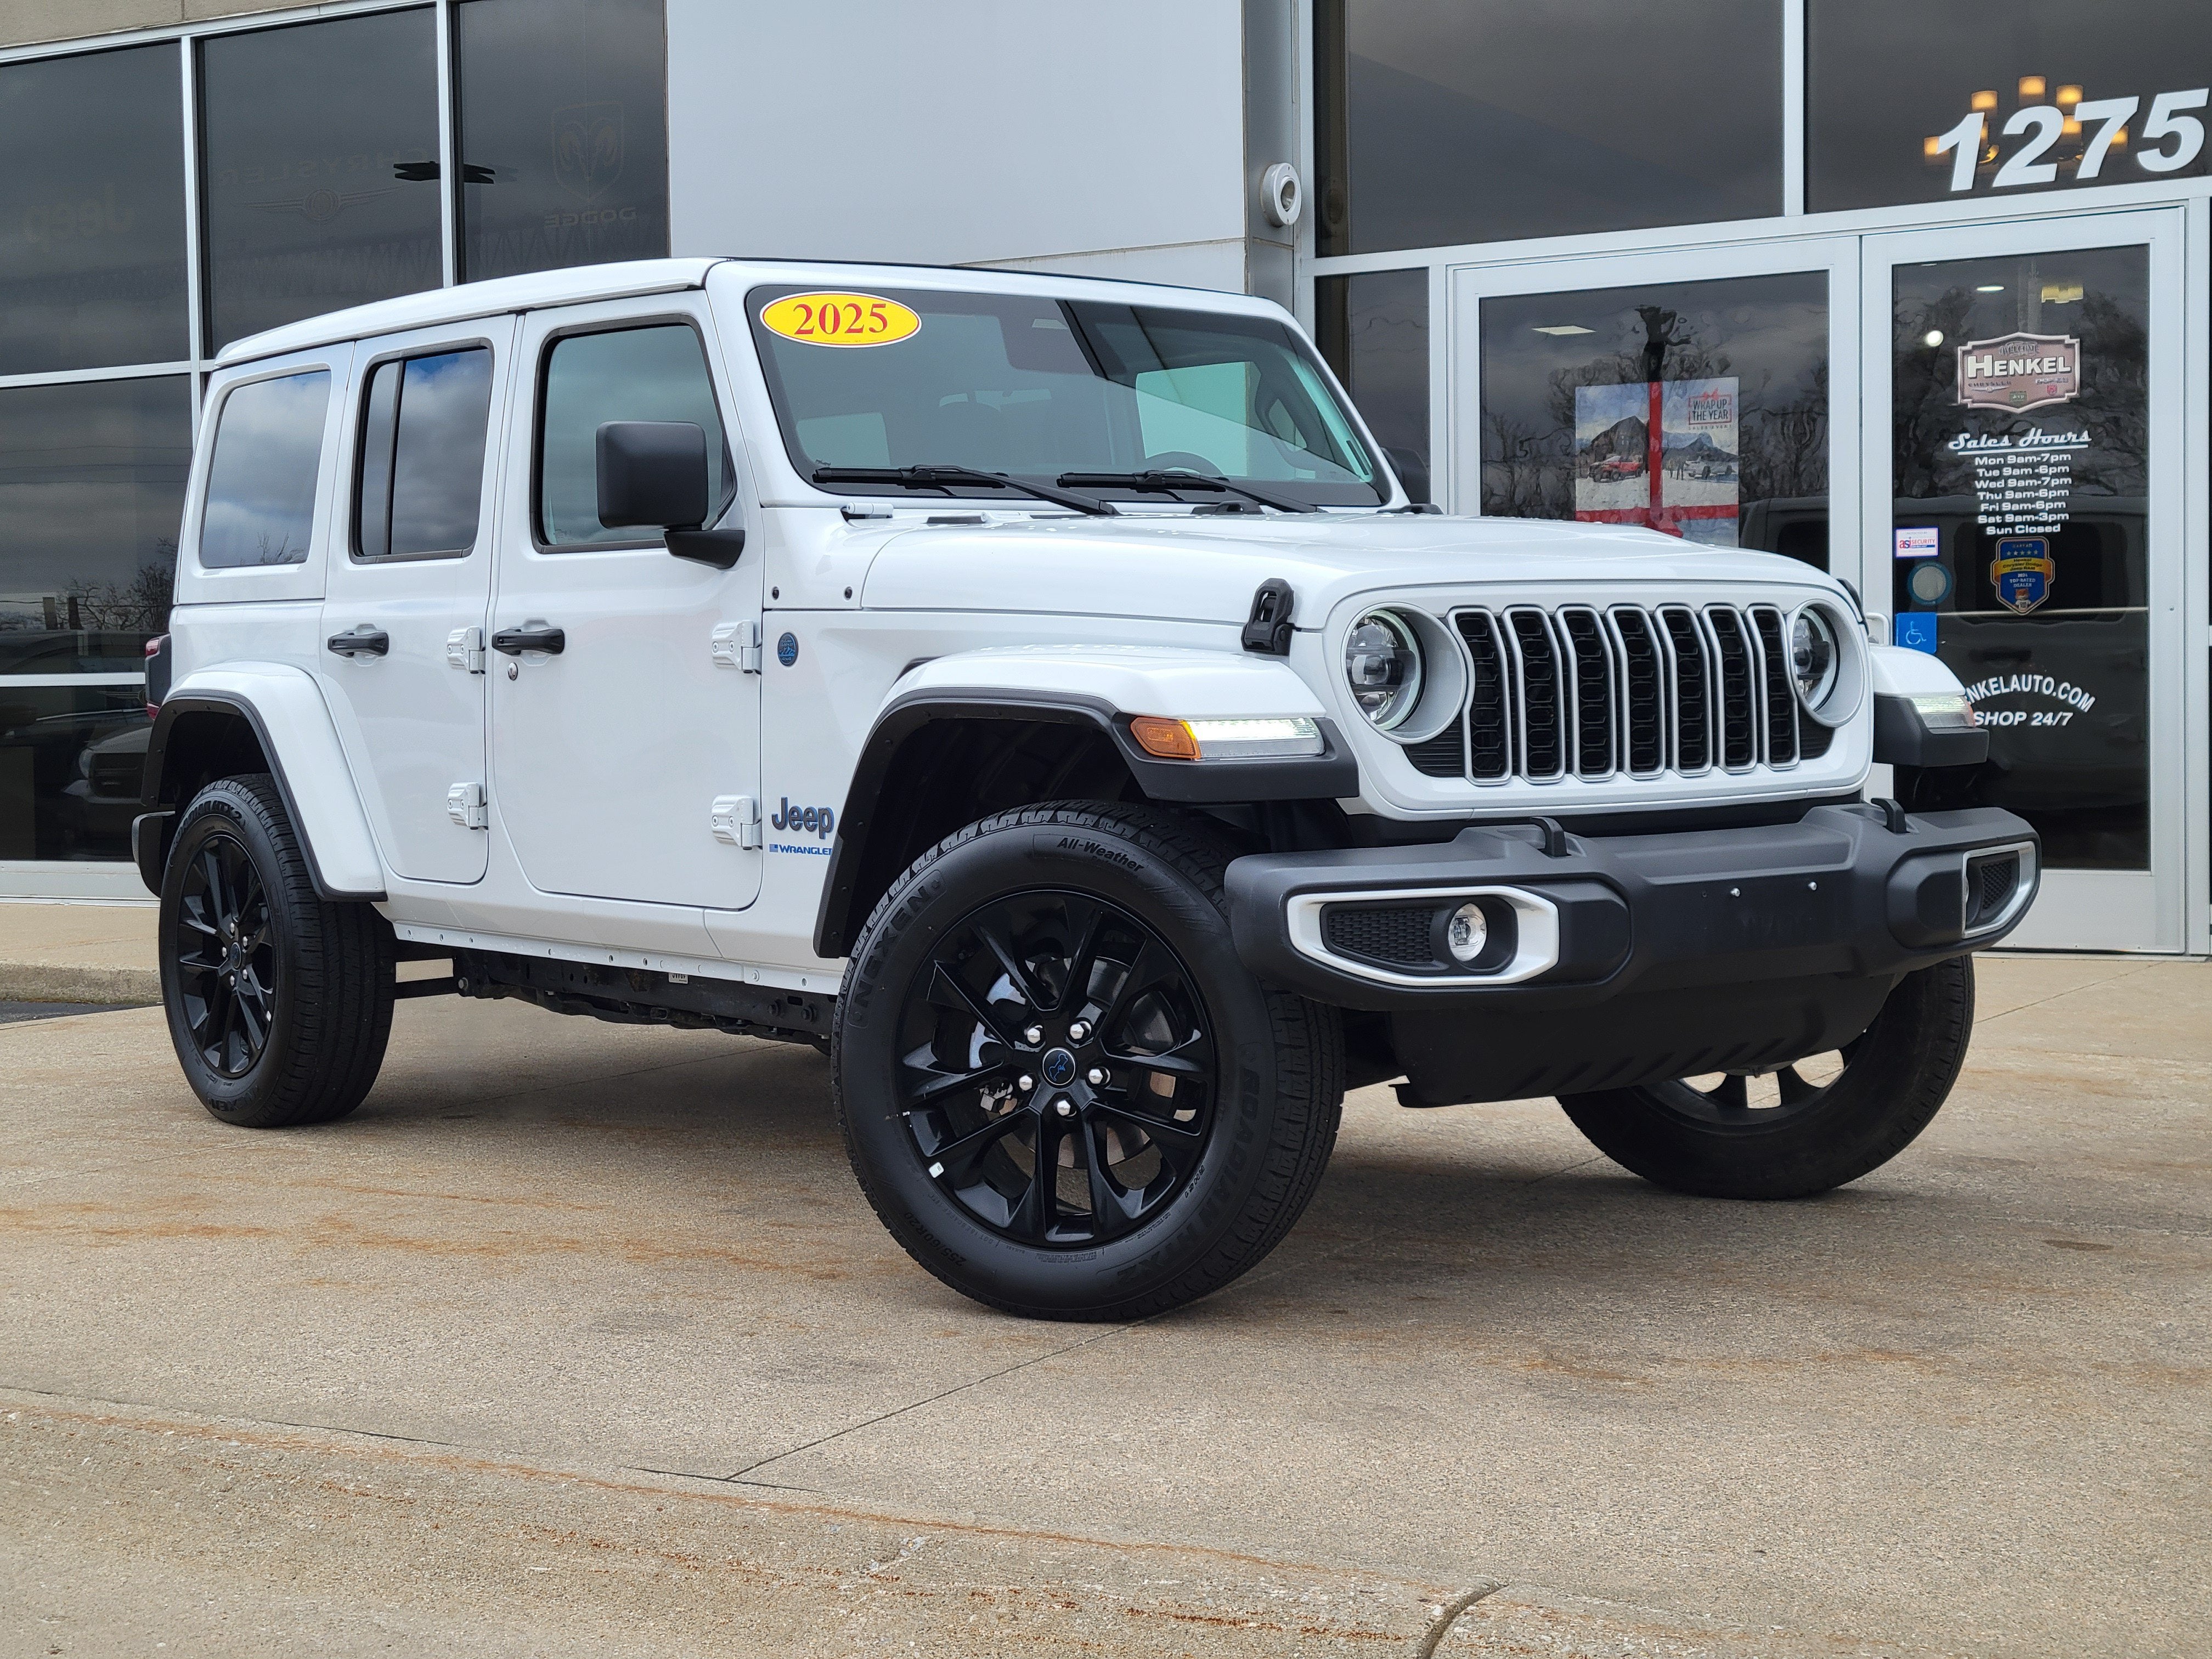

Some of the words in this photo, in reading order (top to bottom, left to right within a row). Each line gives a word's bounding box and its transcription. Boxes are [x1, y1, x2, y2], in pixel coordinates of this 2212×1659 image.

[1937, 87, 2210, 191] 1275
[793, 303, 888, 335] 2025
[1967, 355, 2071, 379] HENKEL
[1693, 399, 1716, 410] WRAP
[1717, 399, 1727, 409] UP
[1692, 411, 1707, 421] THE
[1708, 409, 1728, 420] YEAR
[1948, 433, 2012, 449] Sales
[2019, 427, 2092, 447] Hours
[1975, 456, 2004, 465] Mon
[2007, 453, 2072, 464] 9am-7pm
[1977, 468, 2000, 477] Tue
[1974, 479, 2004, 489] Wed
[2008, 477, 2072, 488] 9am-7pm
[1977, 492, 2002, 500] Thu
[2005, 489, 2069, 499] 9am-6pm
[1980, 503, 1999, 511] Fri
[2002, 500, 2066, 511] 9am-6pm
[1978, 515, 2002, 523] Sat
[2005, 512, 2069, 523] 9am-3pm
[1986, 526, 2012, 535] Sun
[2015, 523, 2061, 534] Closed
[1965, 674, 2096, 713] NKELAUTO.COM
[1974, 711, 2027, 726] SHOP
[2031, 711, 2074, 726] 24/7
[771, 797, 834, 840] Jeep
[1057, 837, 1144, 872] All-Weather
[854, 885, 932, 1008] NEXEN
[905, 1211, 967, 1267] 255/60R20
